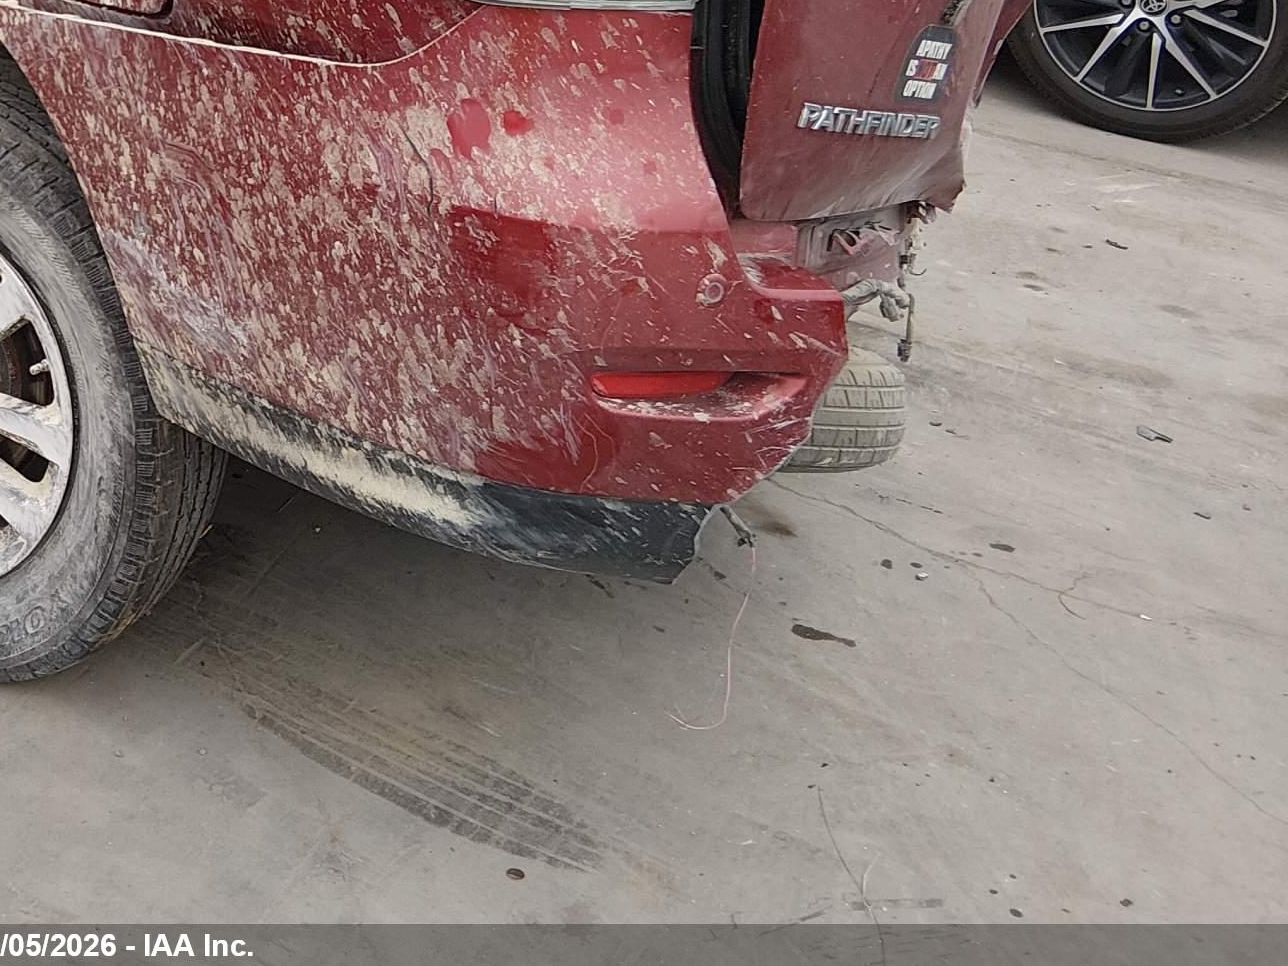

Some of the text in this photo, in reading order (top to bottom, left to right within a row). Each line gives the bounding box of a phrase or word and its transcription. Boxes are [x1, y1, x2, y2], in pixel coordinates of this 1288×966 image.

[915, 39, 953, 60] APATHY
[905, 58, 919, 77] IS
[902, 79, 938, 99] OPTION
[797, 102, 941, 140] PATHFINDER
